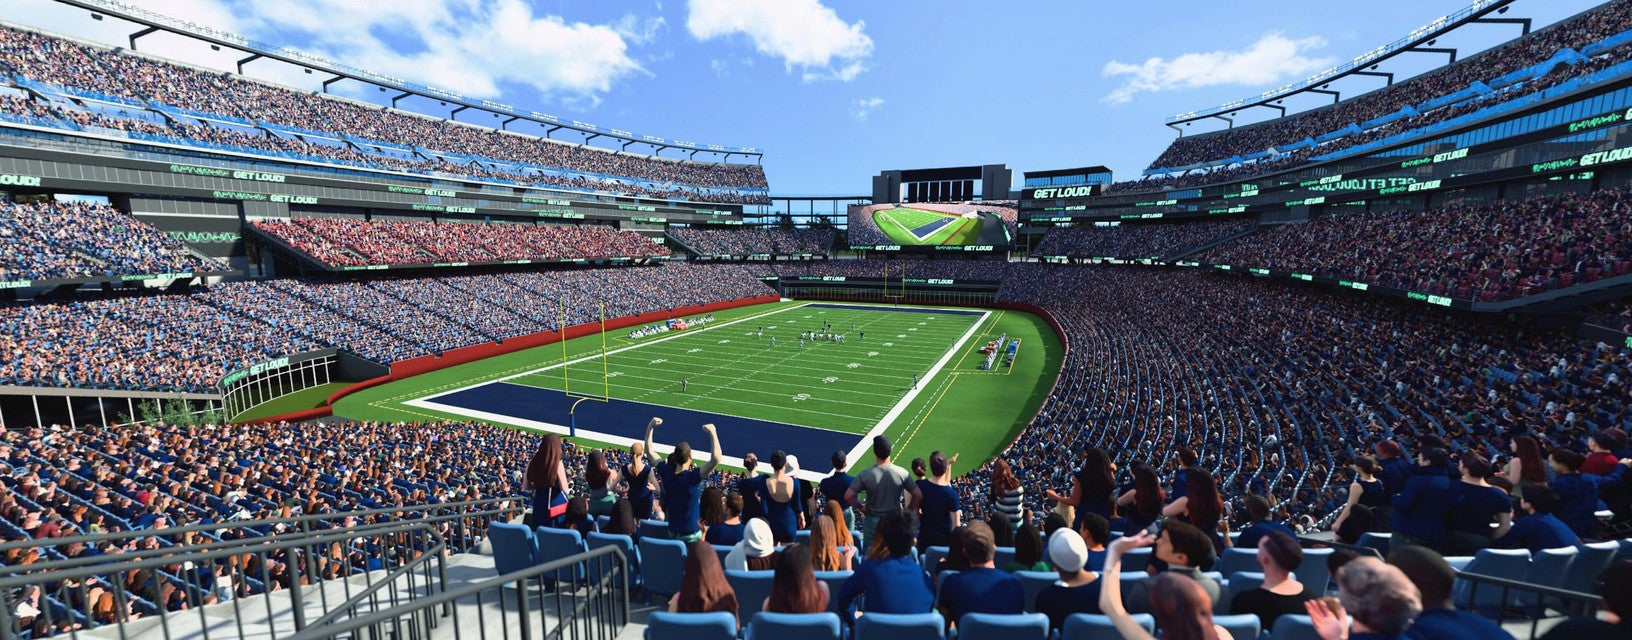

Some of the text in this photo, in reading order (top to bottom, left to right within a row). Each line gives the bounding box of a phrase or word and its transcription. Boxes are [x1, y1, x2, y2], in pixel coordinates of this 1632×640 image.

[1433, 152, 1447, 163] GET
[1580, 151, 1604, 166] GET
[0, 174, 41, 187] OUD!
[233, 170, 285, 183] GET LOUD!
[1033, 186, 1092, 199] GET LOUD!
[1408, 182, 1422, 192] GET
[270, 193, 318, 205] GET LOUD!
[438, 190, 456, 198] LOUD!
[446, 205, 476, 214] GET LOUD!
[249, 356, 289, 375] GET LOUD!
